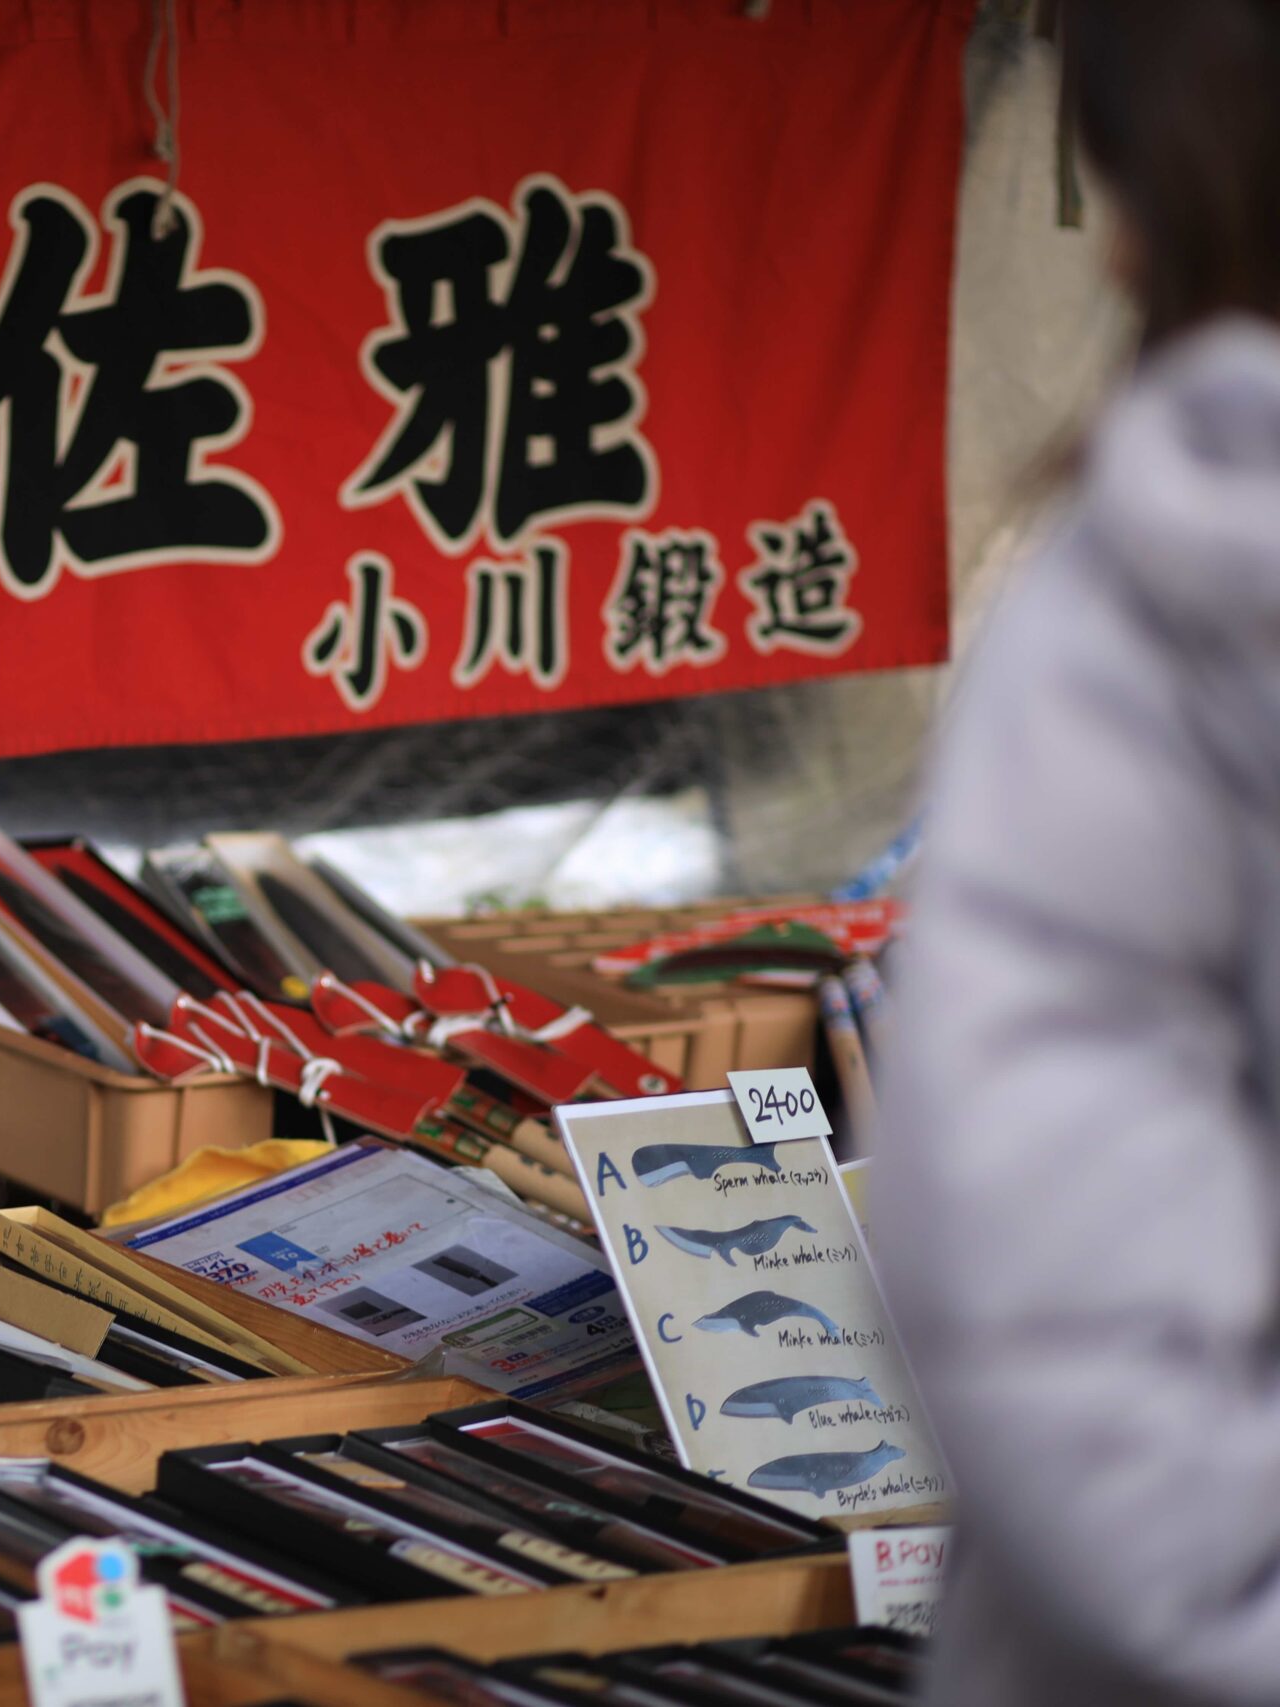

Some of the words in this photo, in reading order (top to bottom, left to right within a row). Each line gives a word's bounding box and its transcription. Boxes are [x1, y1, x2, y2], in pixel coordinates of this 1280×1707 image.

[302, 498, 862, 711] 小川鍛造
[748, 1085, 815, 1126] 2400
[597, 1152, 627, 1196] A
[713, 1172, 749, 1197] Sperm
[623, 1224, 649, 1265] B
[753, 1251, 789, 1272] Minke
[657, 1313, 683, 1343] C
[778, 1328, 814, 1349] Minke
[686, 1393, 706, 1431] D
